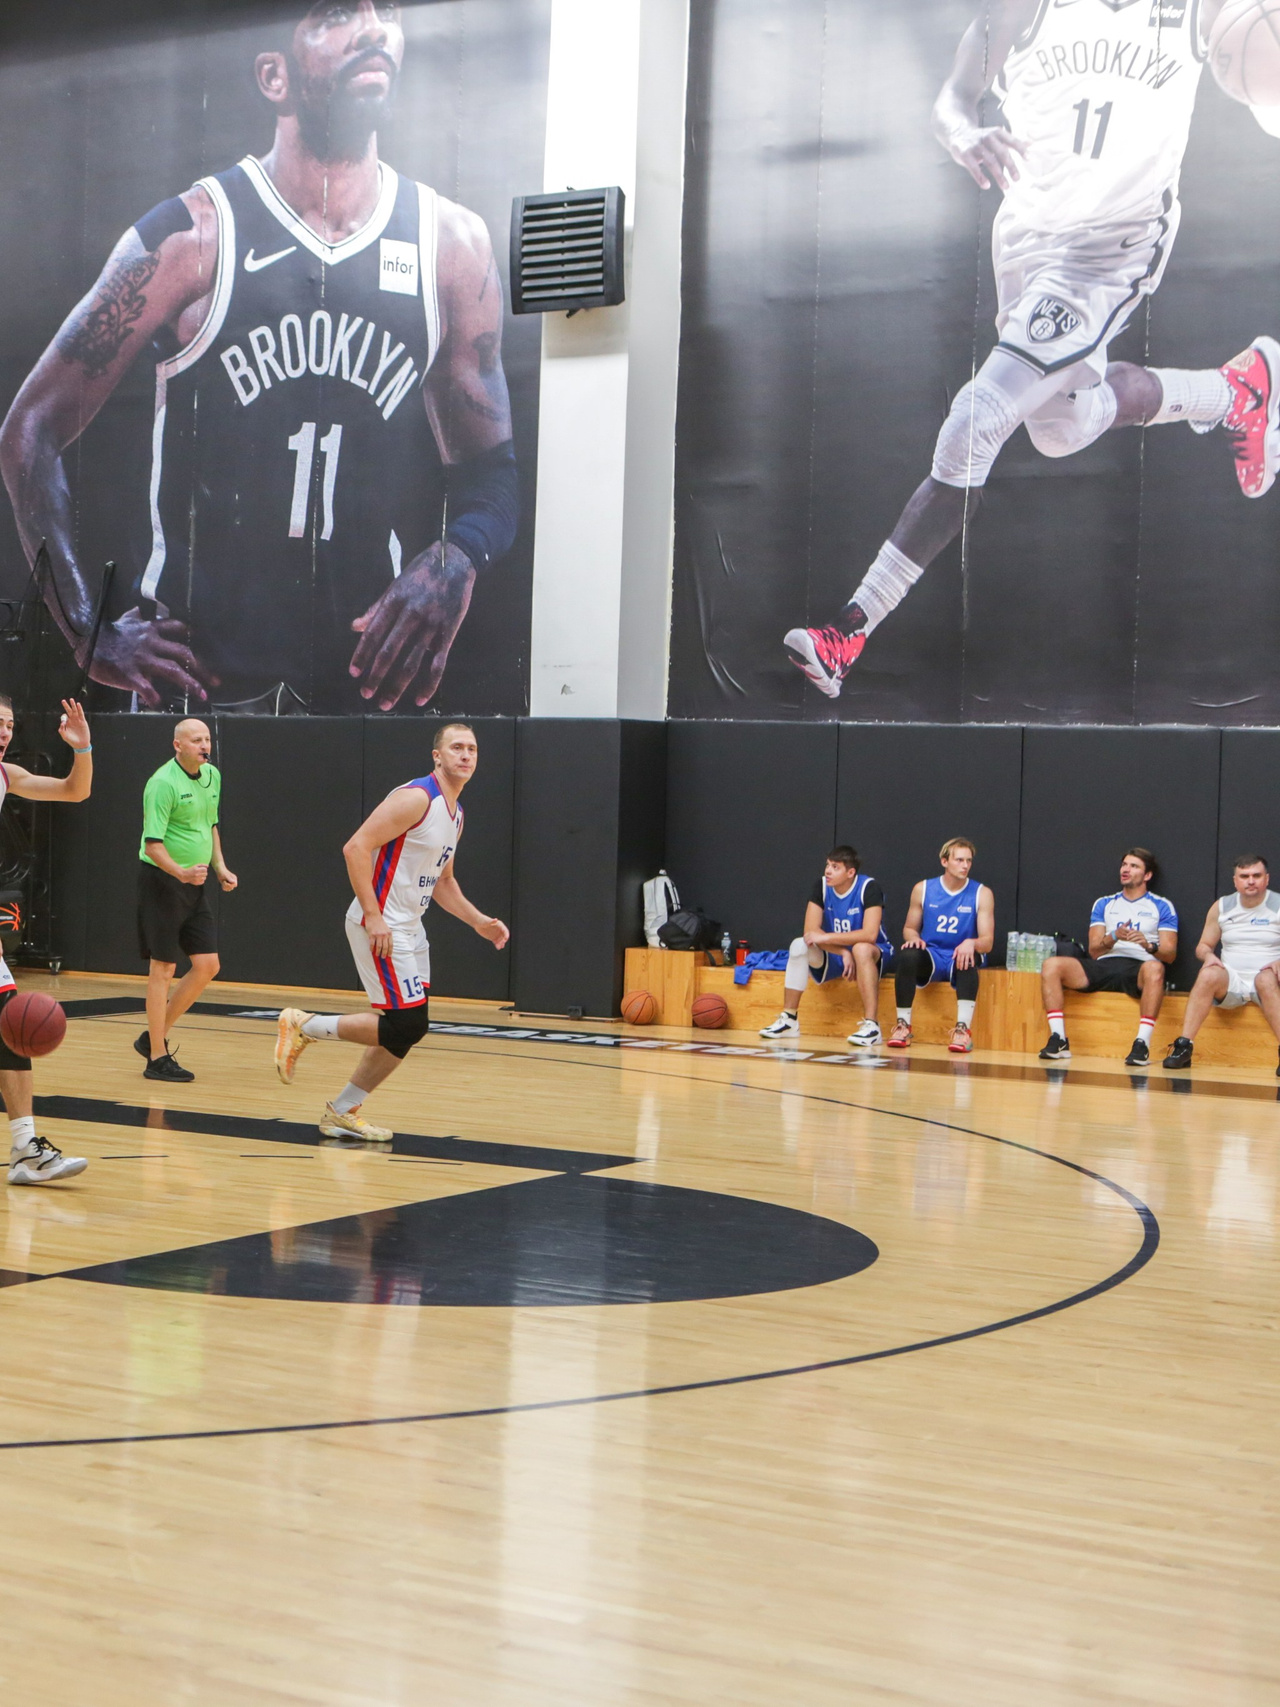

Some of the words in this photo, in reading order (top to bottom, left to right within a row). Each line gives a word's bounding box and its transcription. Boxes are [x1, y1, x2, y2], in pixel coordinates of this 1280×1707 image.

[1036, 38, 1184, 90] BROOKLYN
[1072, 98, 1114, 160] 11
[383, 255, 414, 275] infor
[1034, 299, 1077, 333] NETS
[220, 310, 419, 420] BROOKLYN
[287, 422, 343, 541] 11
[833, 918, 851, 933] 69
[936, 914, 959, 934] 22
[403, 975, 423, 998] 15
